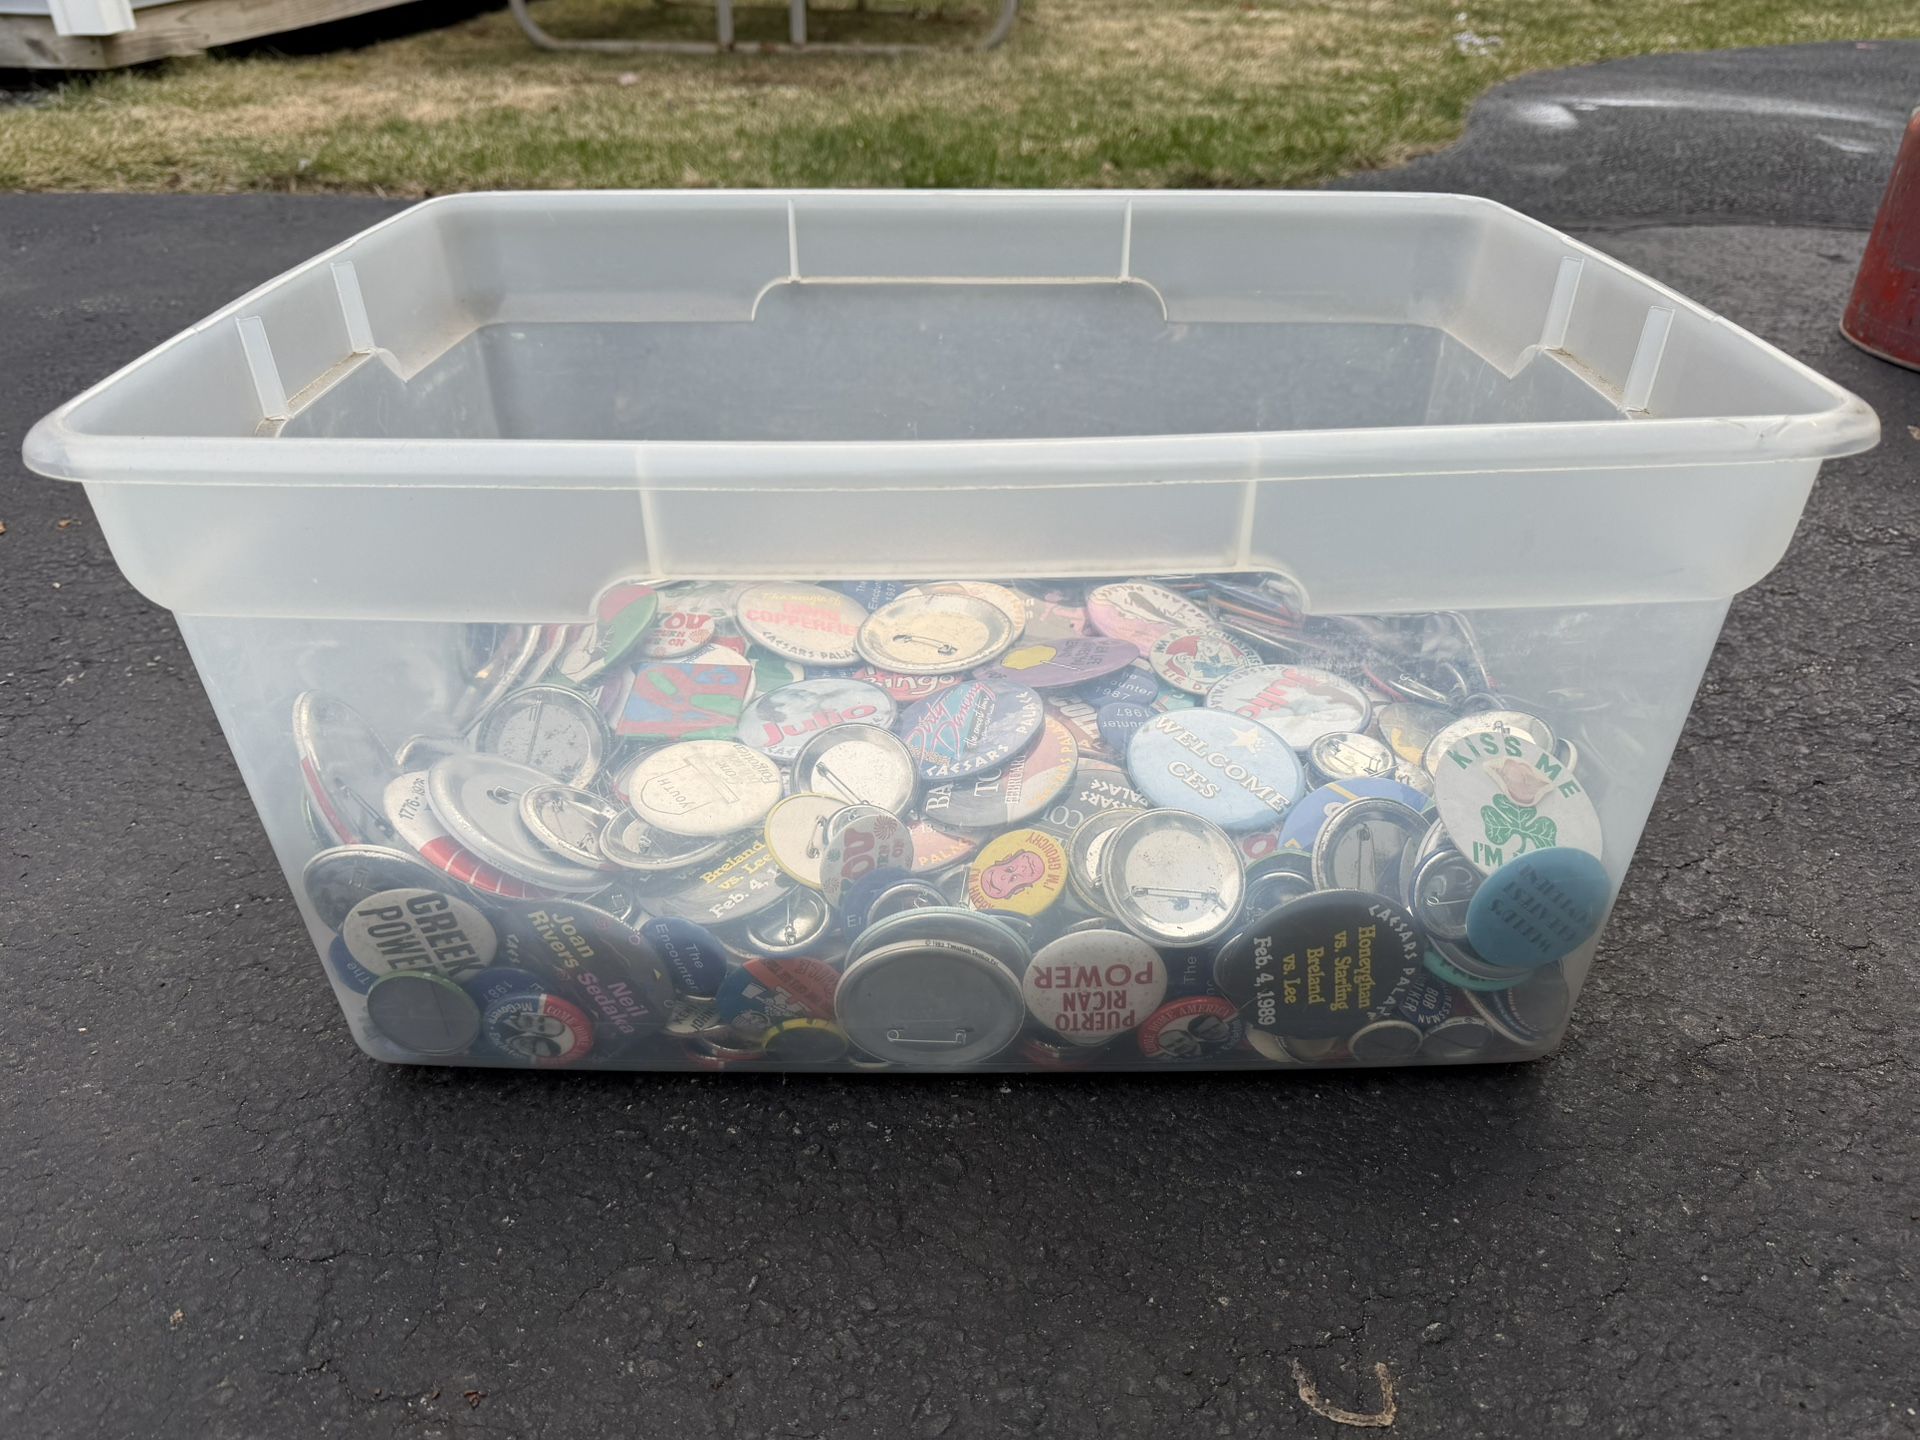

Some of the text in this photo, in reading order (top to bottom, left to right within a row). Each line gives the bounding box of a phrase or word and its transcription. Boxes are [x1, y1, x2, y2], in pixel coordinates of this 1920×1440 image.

[746, 609, 859, 637] COPPERFIE
[761, 631, 857, 660] CAESARS PALA
[1095, 686, 1131, 701] 1987
[1110, 679, 1154, 697] ounter
[761, 704, 878, 748] Julio
[926, 743, 1010, 776] CAESARS
[1015, 691, 1037, 735] PALACE
[1156, 714, 1291, 814] WELCOME
[1167, 760, 1222, 799] CES
[1447, 732, 1582, 799] KISS ME
[657, 777, 696, 809] YOUTH
[700, 840, 767, 884] Breland
[1025, 831, 1062, 871] GROUCHY
[1472, 841, 1503, 867] I'M
[717, 875, 745, 890] vs.
[741, 853, 773, 875] Lee
[709, 879, 769, 918] Feb. 4,
[406, 892, 488, 977] GREEK
[527, 910, 590, 968] Rivers
[551, 912, 595, 958] Joan
[1368, 903, 1418, 961] CAESARS
[351, 961, 372, 985] The
[656, 923, 699, 990] Encounter
[686, 943, 704, 969] The
[1032, 961, 1153, 989] POWER
[1183, 955, 1199, 985] The
[1306, 946, 1327, 1005] Breland
[1330, 930, 1354, 1012] vs. Starling
[1353, 924, 1377, 1009] Honeyghan
[1254, 935, 1277, 1026] Feb. 4, 1989
[1283, 952, 1301, 1005] vs. Lee
[1423, 986, 1440, 1010] BOB
[576, 972, 635, 1034] Sedaka
[607, 982, 649, 1017] Neil
[1063, 989, 1127, 1012] RICAN
[1055, 1010, 1135, 1031] PUERTO
